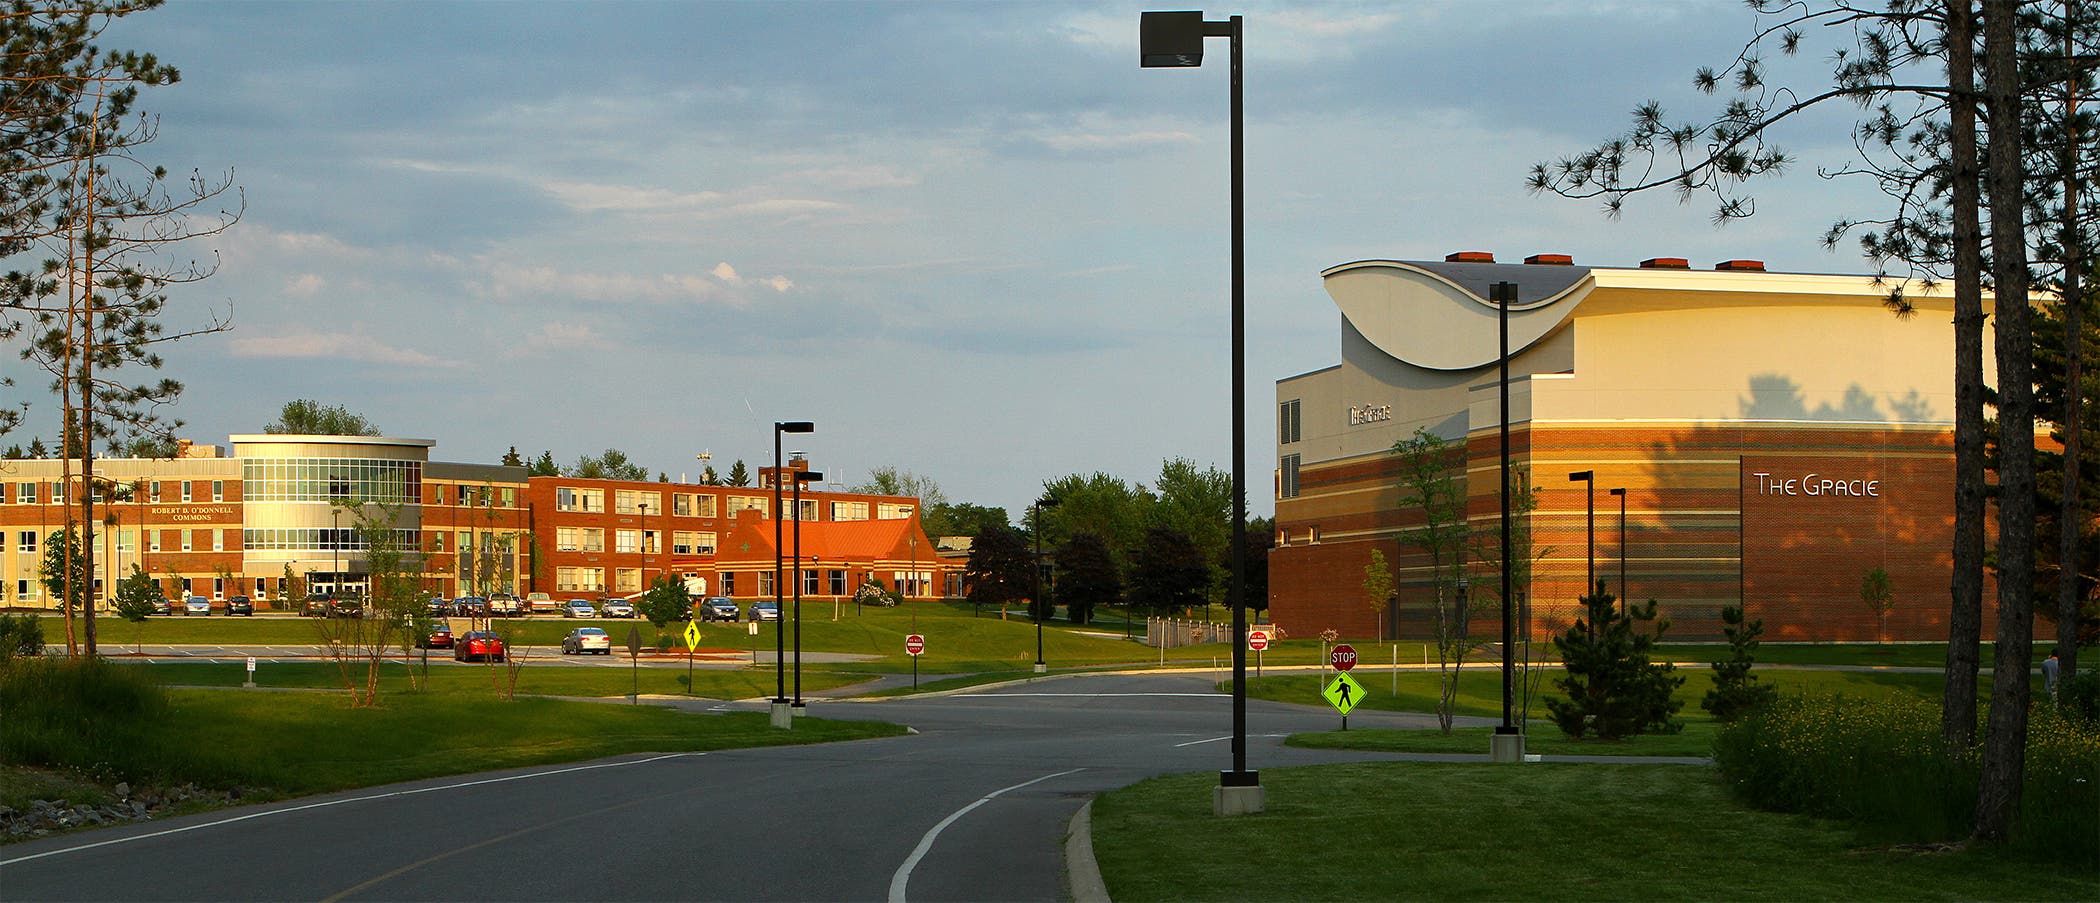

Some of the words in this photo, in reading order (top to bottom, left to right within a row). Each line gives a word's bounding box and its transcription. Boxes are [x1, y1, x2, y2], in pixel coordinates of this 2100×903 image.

[1753, 473, 1797, 495] THE
[1802, 473, 1879, 497] GRACIE
[191, 506, 233, 514] O'DONNELL
[1332, 652, 1356, 663] STOP
